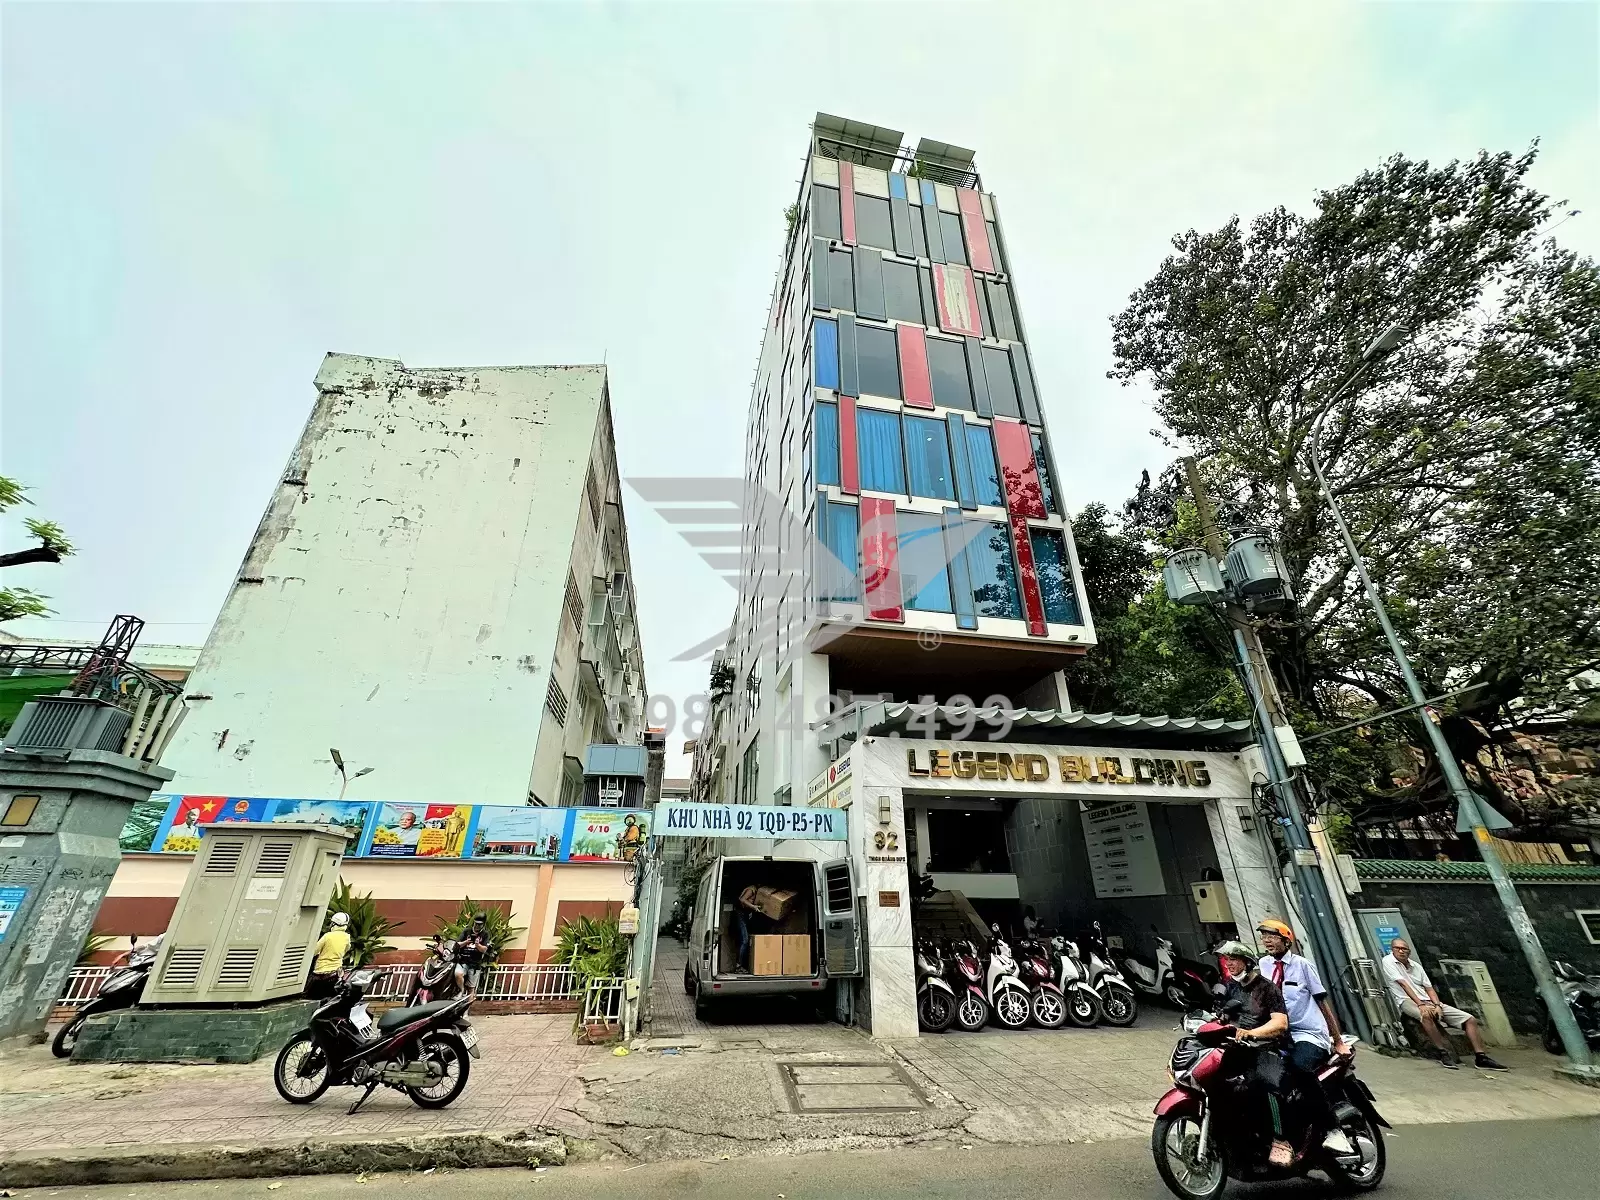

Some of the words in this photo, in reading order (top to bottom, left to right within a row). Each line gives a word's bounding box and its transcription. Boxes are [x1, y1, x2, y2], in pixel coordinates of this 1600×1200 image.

[907, 748, 1050, 781] LEGEND
[1057, 755, 1212, 787] BUILDING
[587, 825, 610, 833] 4/10
[667, 808, 698, 828] KHU
[702, 806, 732, 830] NHÀ
[736, 812, 753, 831] 92
[874, 831, 899, 850] 92
